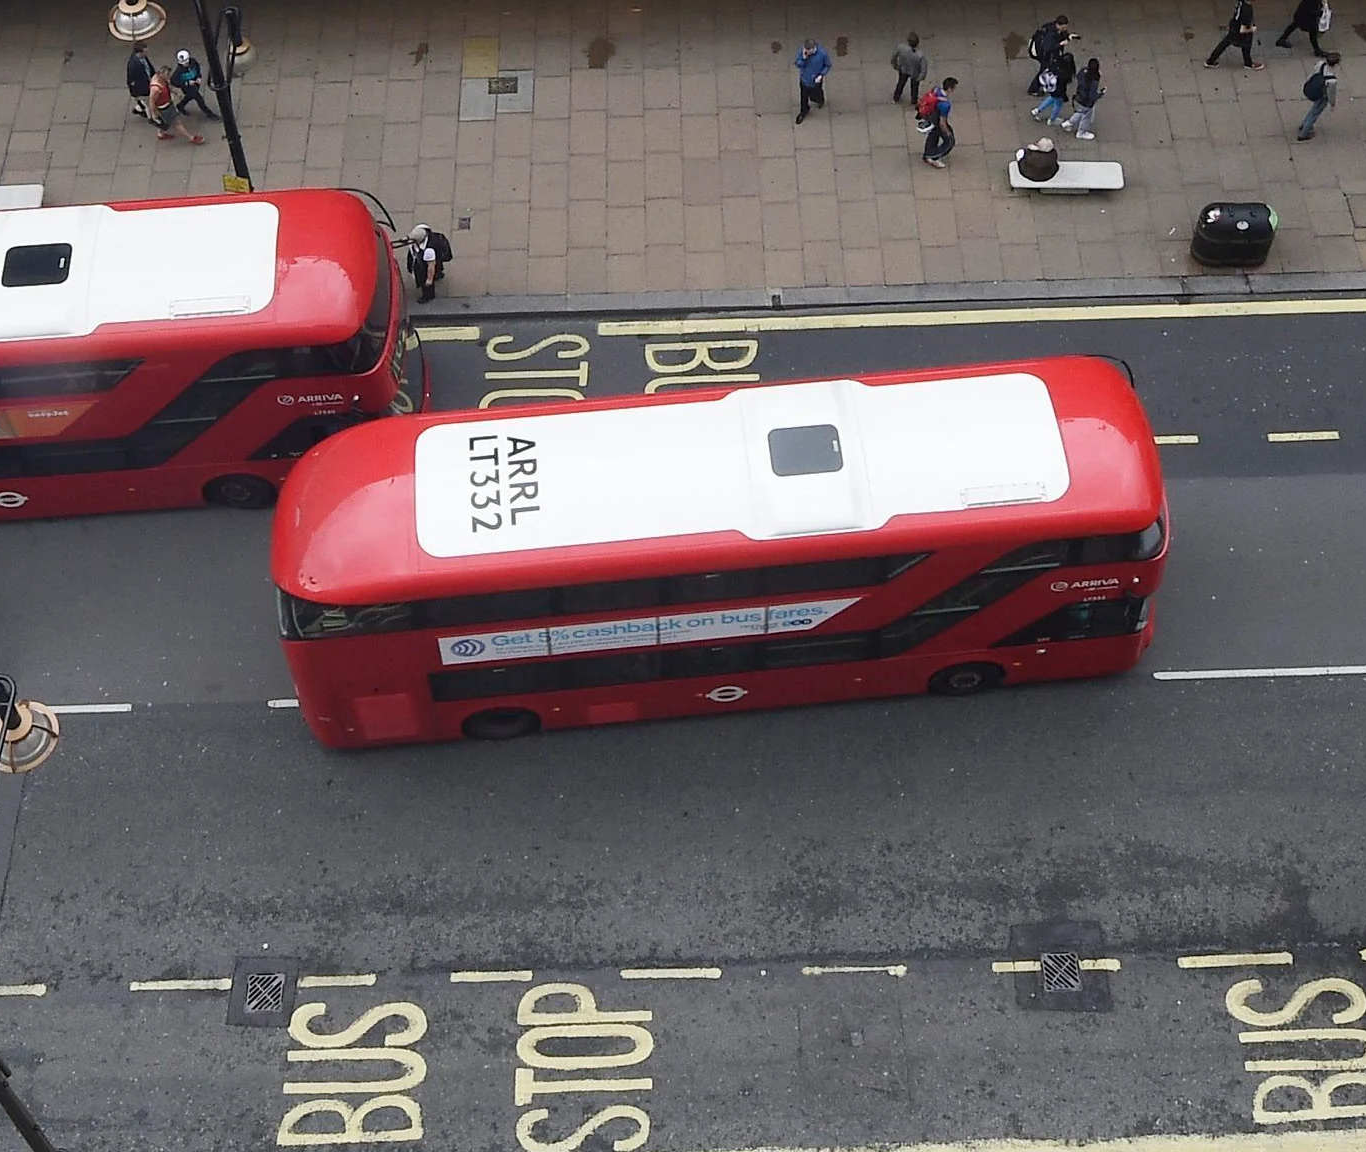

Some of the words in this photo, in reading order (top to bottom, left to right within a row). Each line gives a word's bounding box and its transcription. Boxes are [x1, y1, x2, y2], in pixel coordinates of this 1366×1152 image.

[298, 393, 344, 403] ARRIVA
[469, 435, 503, 533] LT332
[506, 436, 541, 526] ARRL
[1070, 578, 1120, 588] ARRIVA
[491, 632, 532, 646] Get
[538, 629, 570, 643] 5%
[572, 619, 681, 638] cashback
[687, 617, 714, 628] on
[721, 612, 762, 625] bus
[277, 1001, 428, 1146] BUS
[514, 982, 654, 1152] STOP
